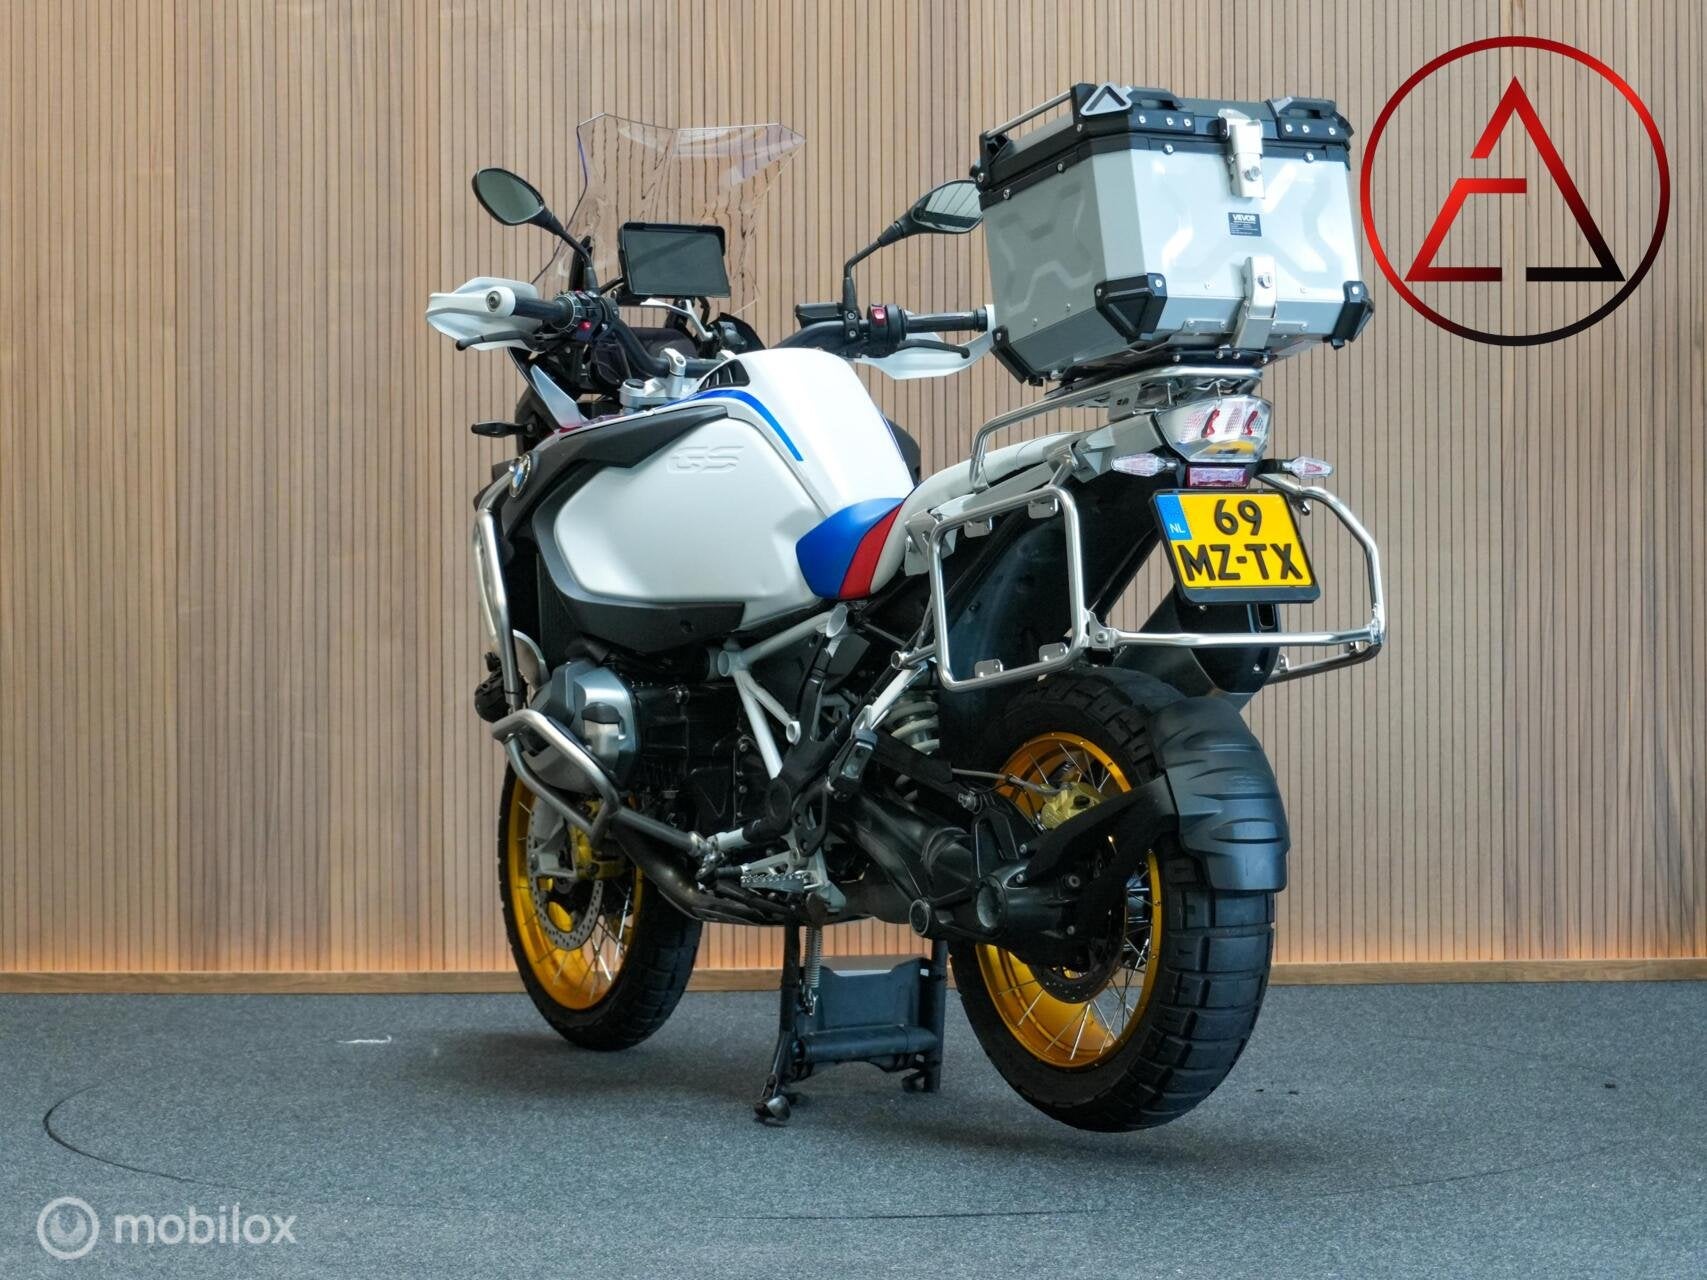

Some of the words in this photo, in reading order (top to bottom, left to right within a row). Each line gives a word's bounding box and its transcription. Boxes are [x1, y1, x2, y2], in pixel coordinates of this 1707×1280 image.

[667, 445, 745, 474] GS
[1169, 523, 1186, 534] NL
[1214, 499, 1263, 536] 69
[1177, 543, 1303, 581] MZ-TX
